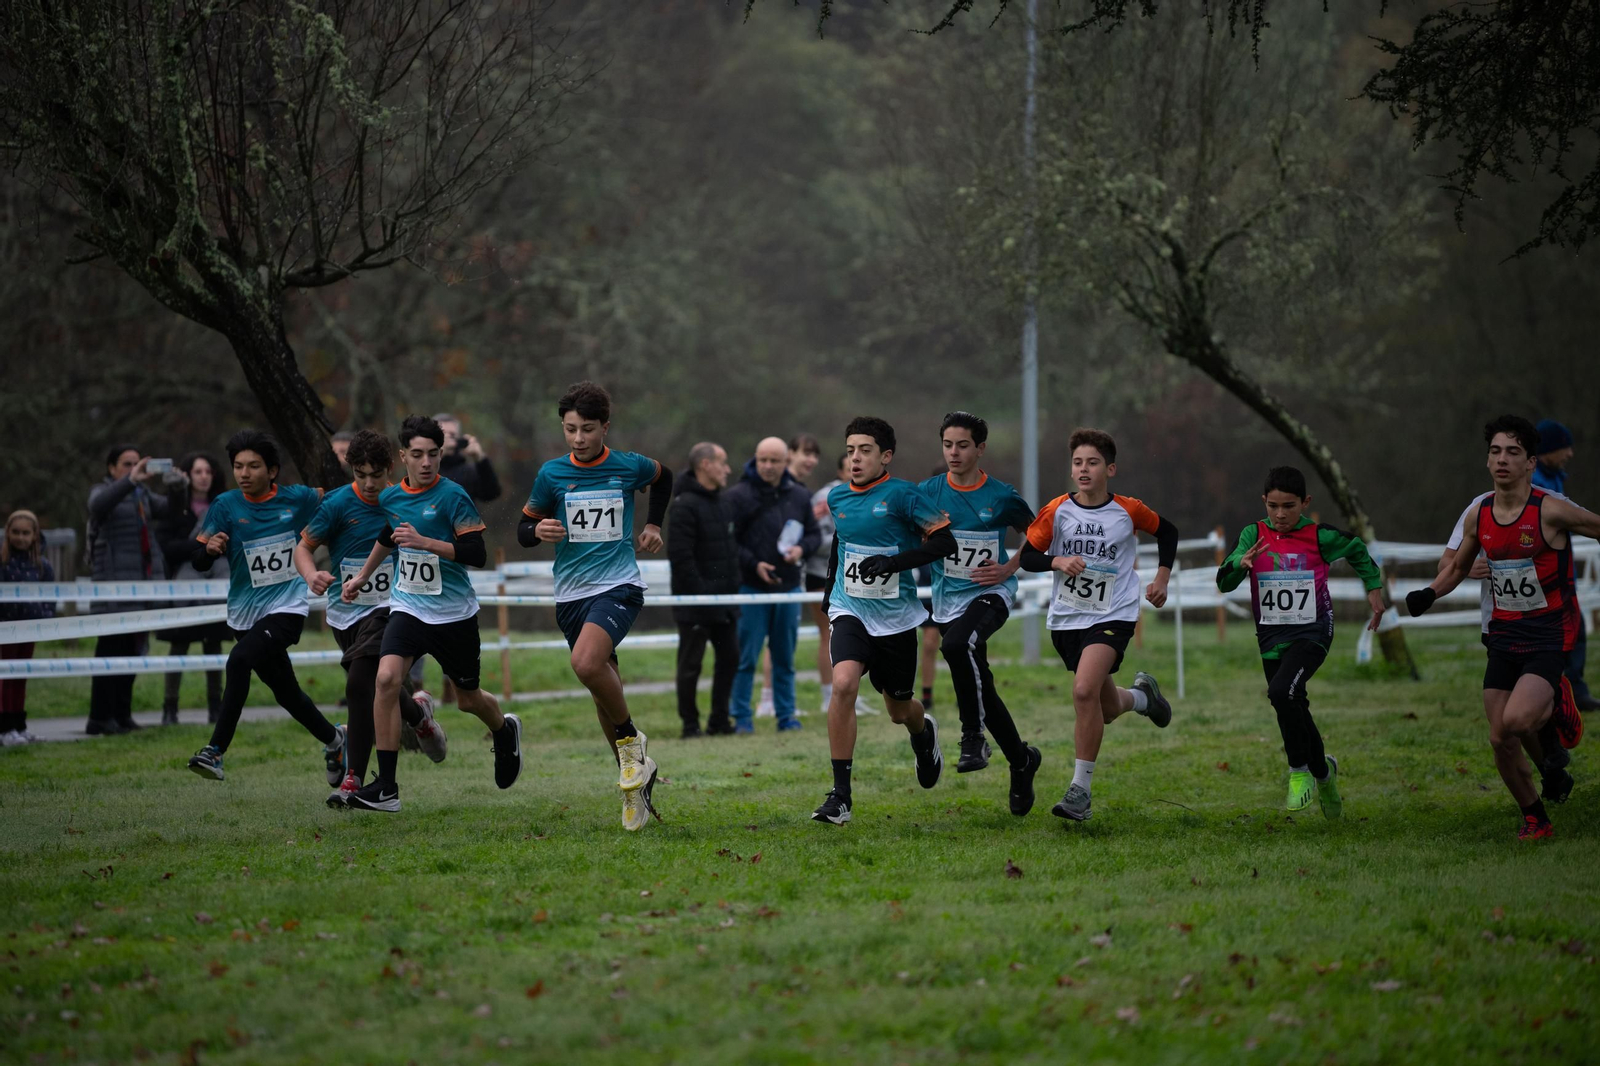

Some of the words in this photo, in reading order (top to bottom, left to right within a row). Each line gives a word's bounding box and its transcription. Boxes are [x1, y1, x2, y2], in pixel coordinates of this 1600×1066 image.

[572, 508, 615, 529] 471
[1074, 524, 1104, 536] ANA
[946, 548, 992, 568] 472
[1062, 540, 1118, 560] MOGAS
[251, 548, 292, 574] 467
[400, 560, 434, 582] 470
[1064, 576, 1106, 602] 431
[1262, 589, 1310, 610] 407
